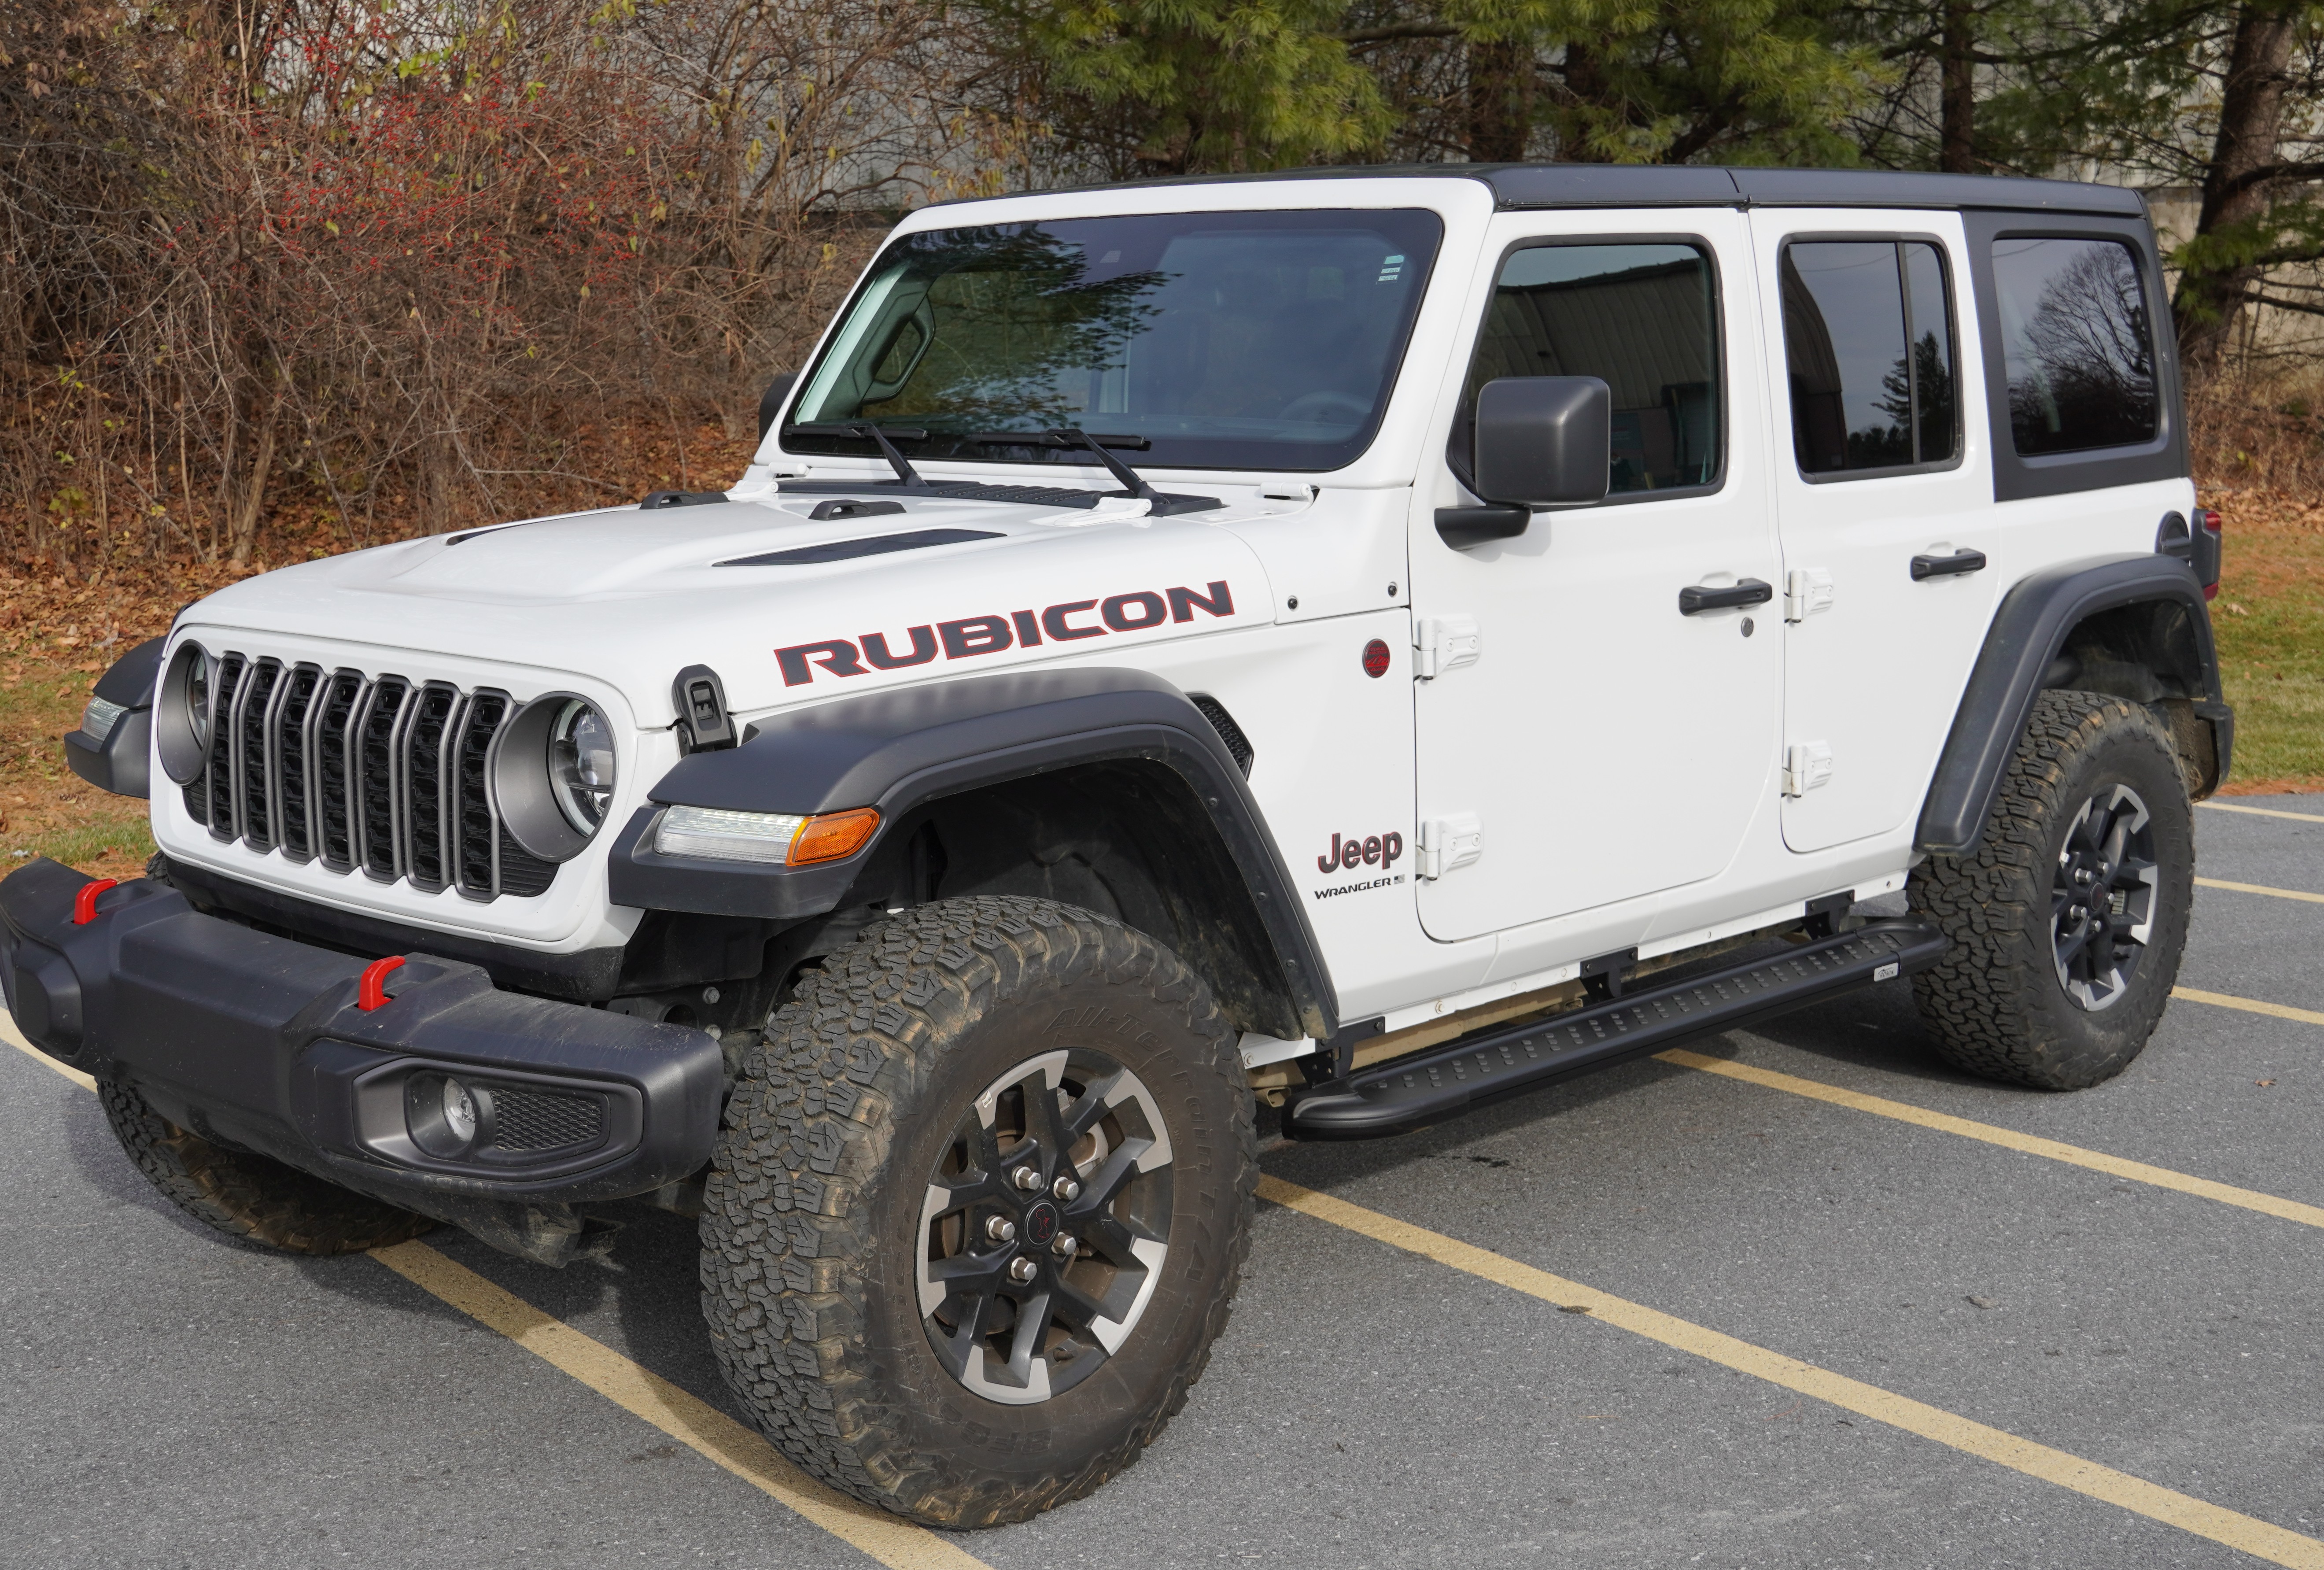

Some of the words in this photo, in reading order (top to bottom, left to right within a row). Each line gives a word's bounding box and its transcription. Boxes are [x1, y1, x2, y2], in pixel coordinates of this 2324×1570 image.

[773, 580, 1236, 687] RUBICON
[1317, 831, 1402, 874] Jeep
[1314, 877, 1391, 900] WRANGLER
[1880, 969, 1894, 978] ROMIK
[1042, 1007, 1213, 1175] All-Terrain
